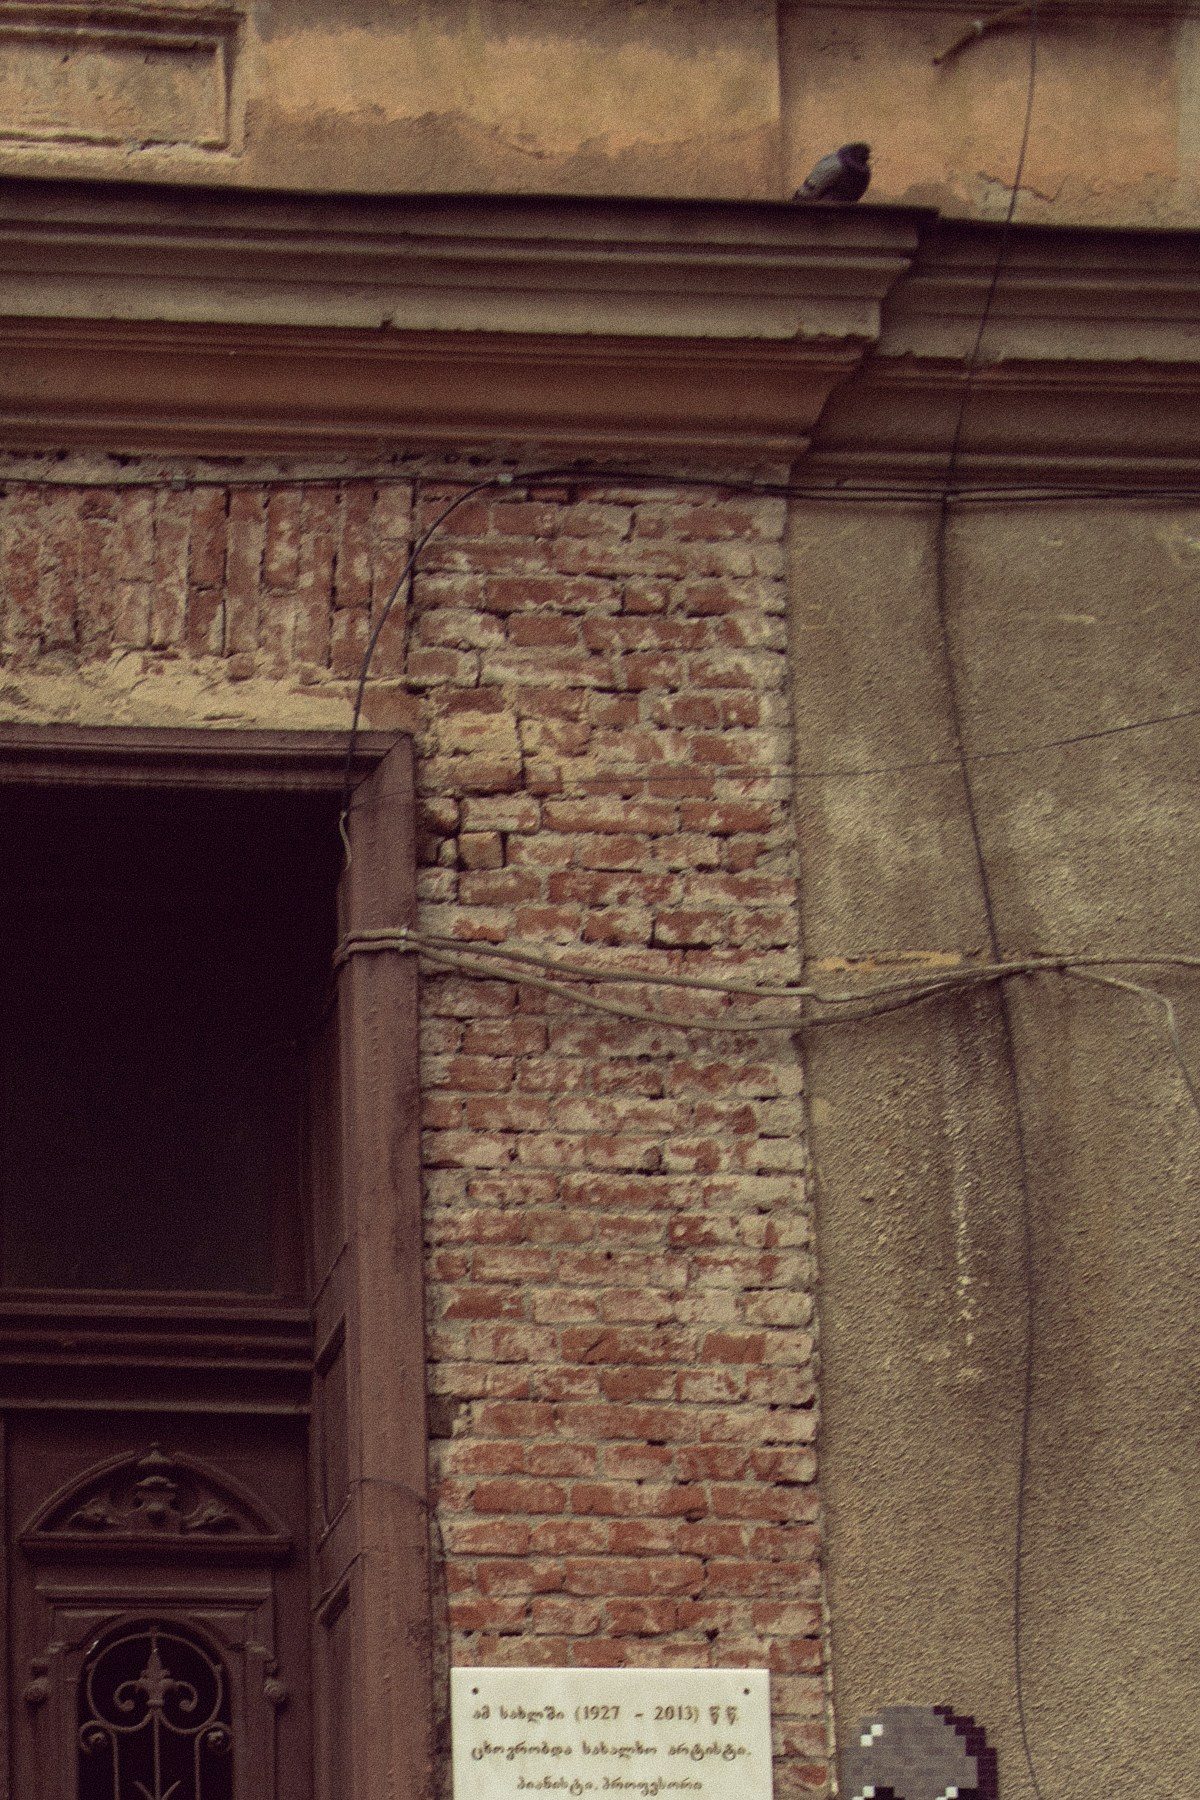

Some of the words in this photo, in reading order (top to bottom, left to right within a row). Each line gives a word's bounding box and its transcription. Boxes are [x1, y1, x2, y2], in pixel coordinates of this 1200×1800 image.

[472, 1704, 490, 1720] ამ
[500, 1704, 564, 1723] სახლში
[574, 1705, 620, 1724] (1927
[654, 1705, 700, 1724] 2013)
